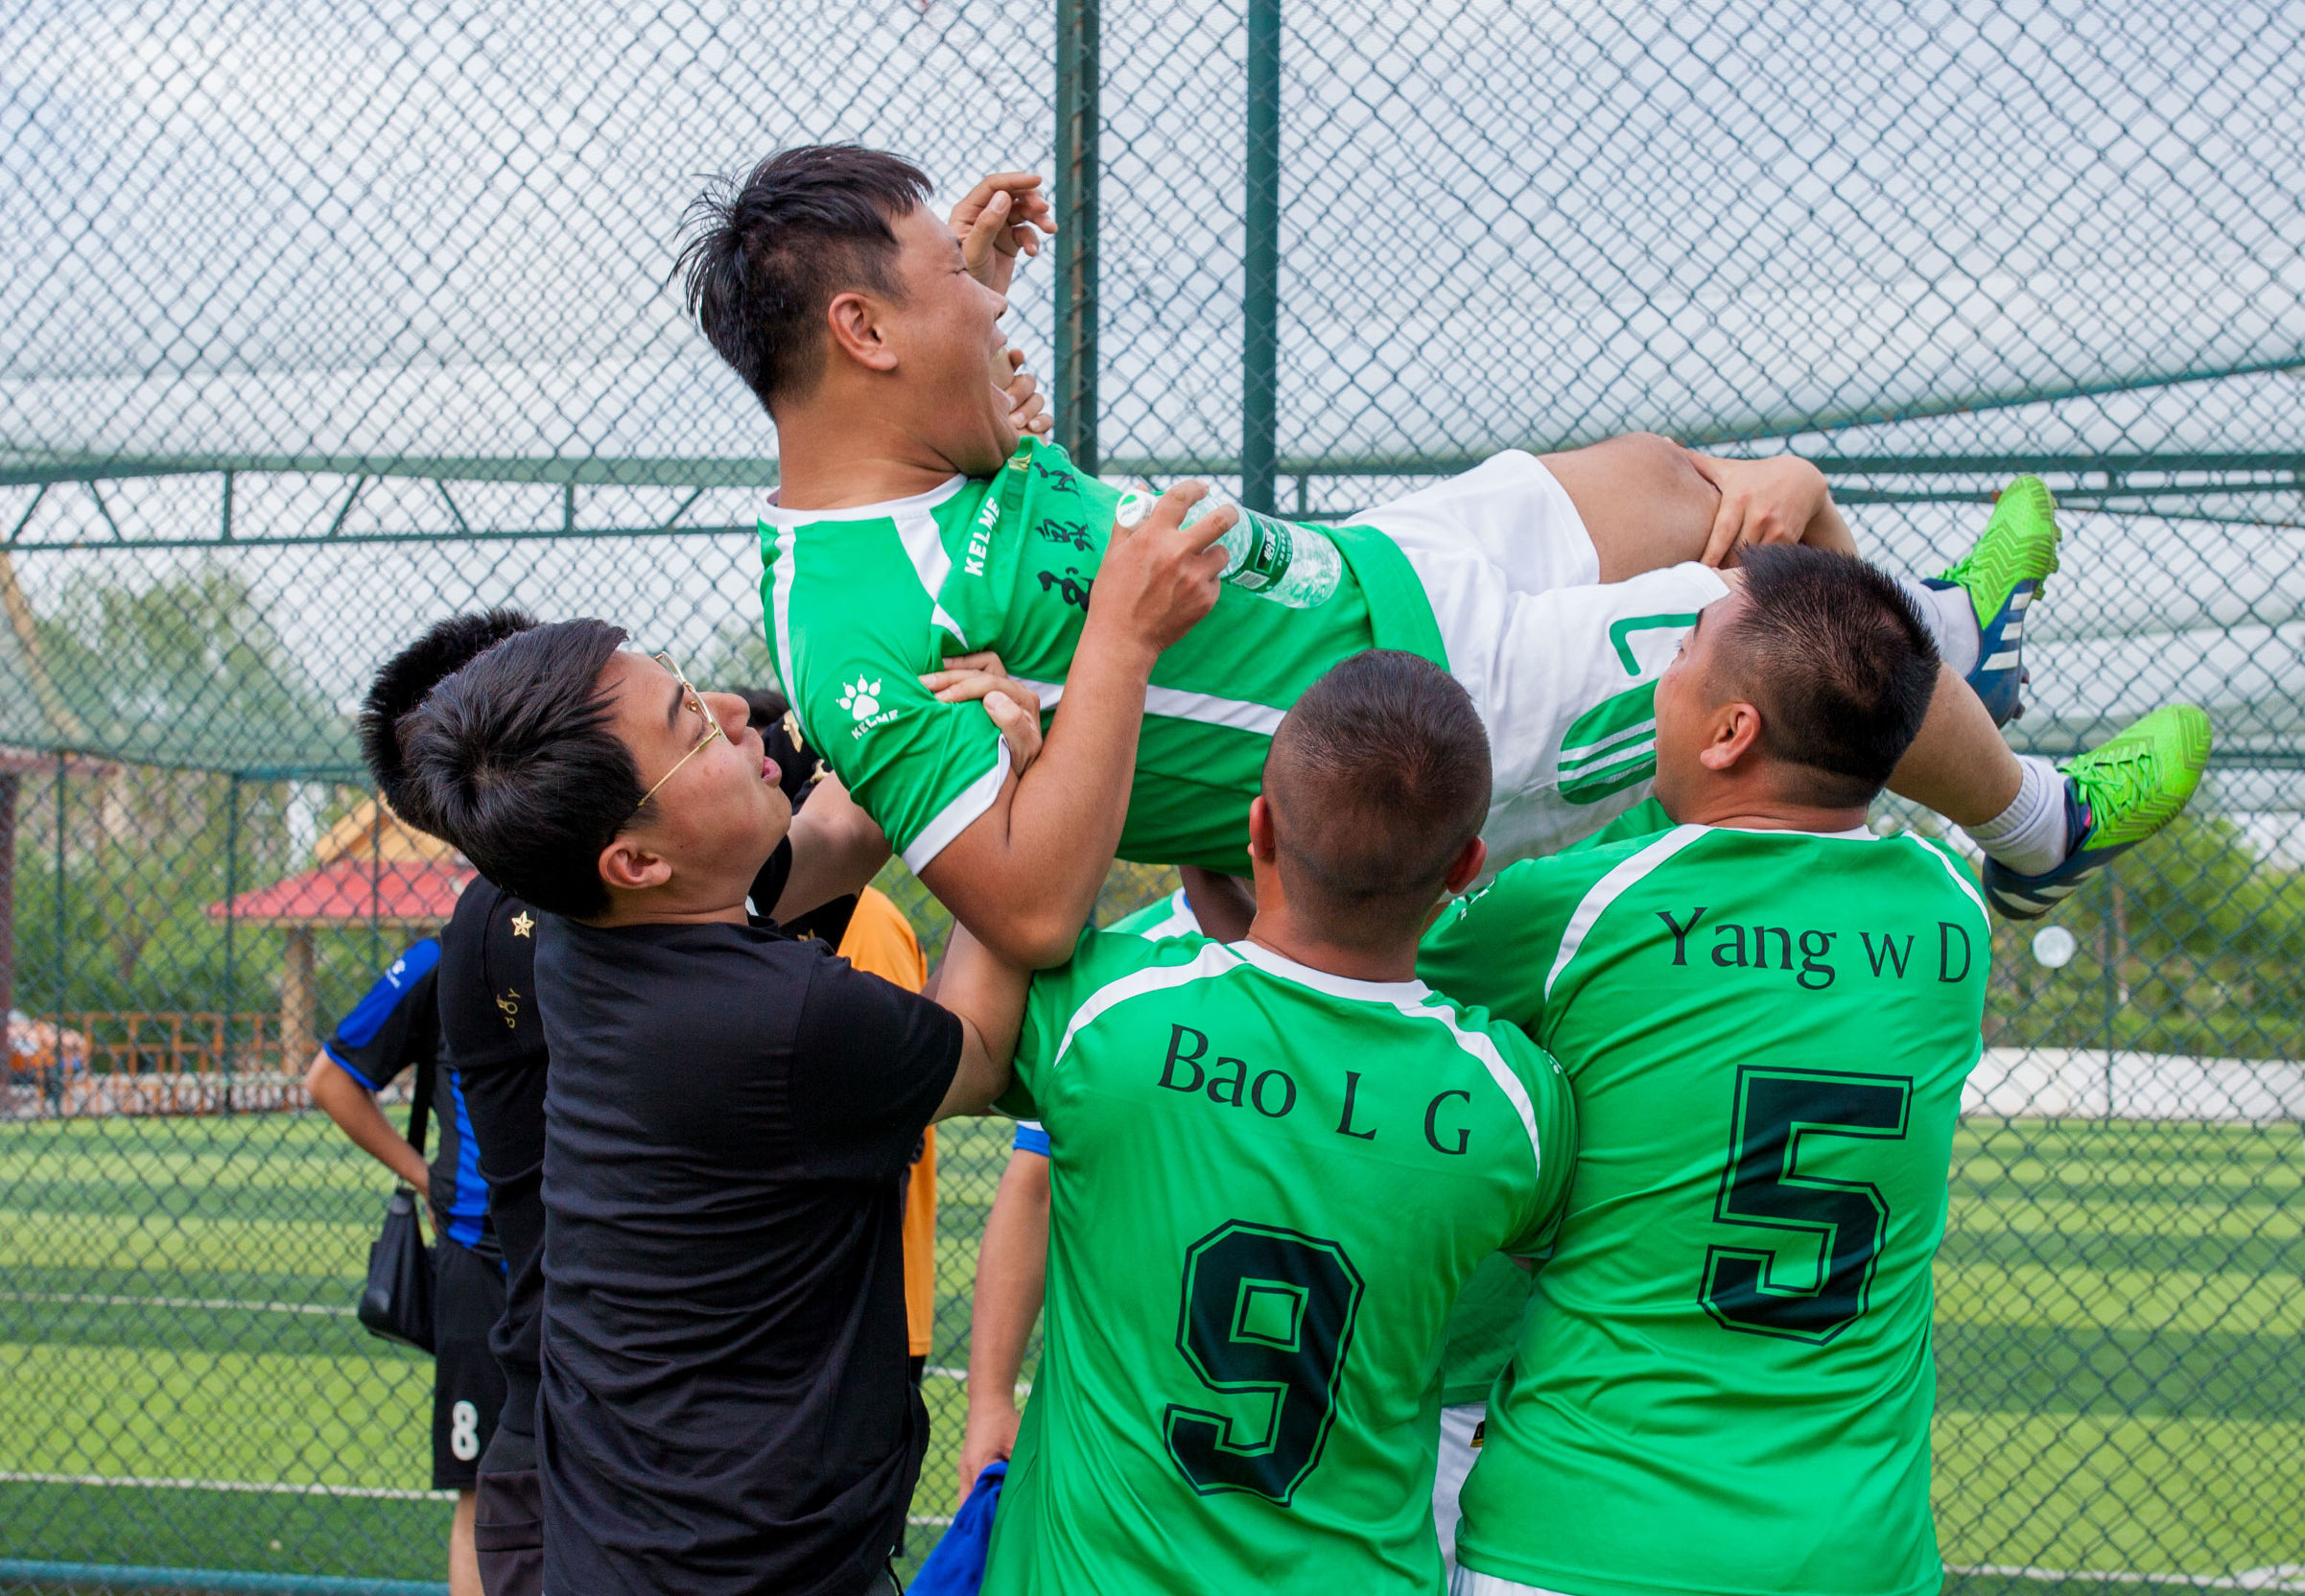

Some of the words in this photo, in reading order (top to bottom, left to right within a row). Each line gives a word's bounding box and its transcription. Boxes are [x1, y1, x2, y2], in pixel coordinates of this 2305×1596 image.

[964, 496, 1000, 576] KELME
[851, 709, 899, 740] KELME
[1655, 906, 1837, 991] Yang
[1937, 921, 1971, 984] D
[1157, 1022, 1297, 1118] Bao
[1335, 1069, 1377, 1141] L
[1424, 1090, 1471, 1156] G
[1697, 1064, 1914, 1346] 5
[1164, 1218, 1366, 1508] 9
[450, 1399, 481, 1462] 8
